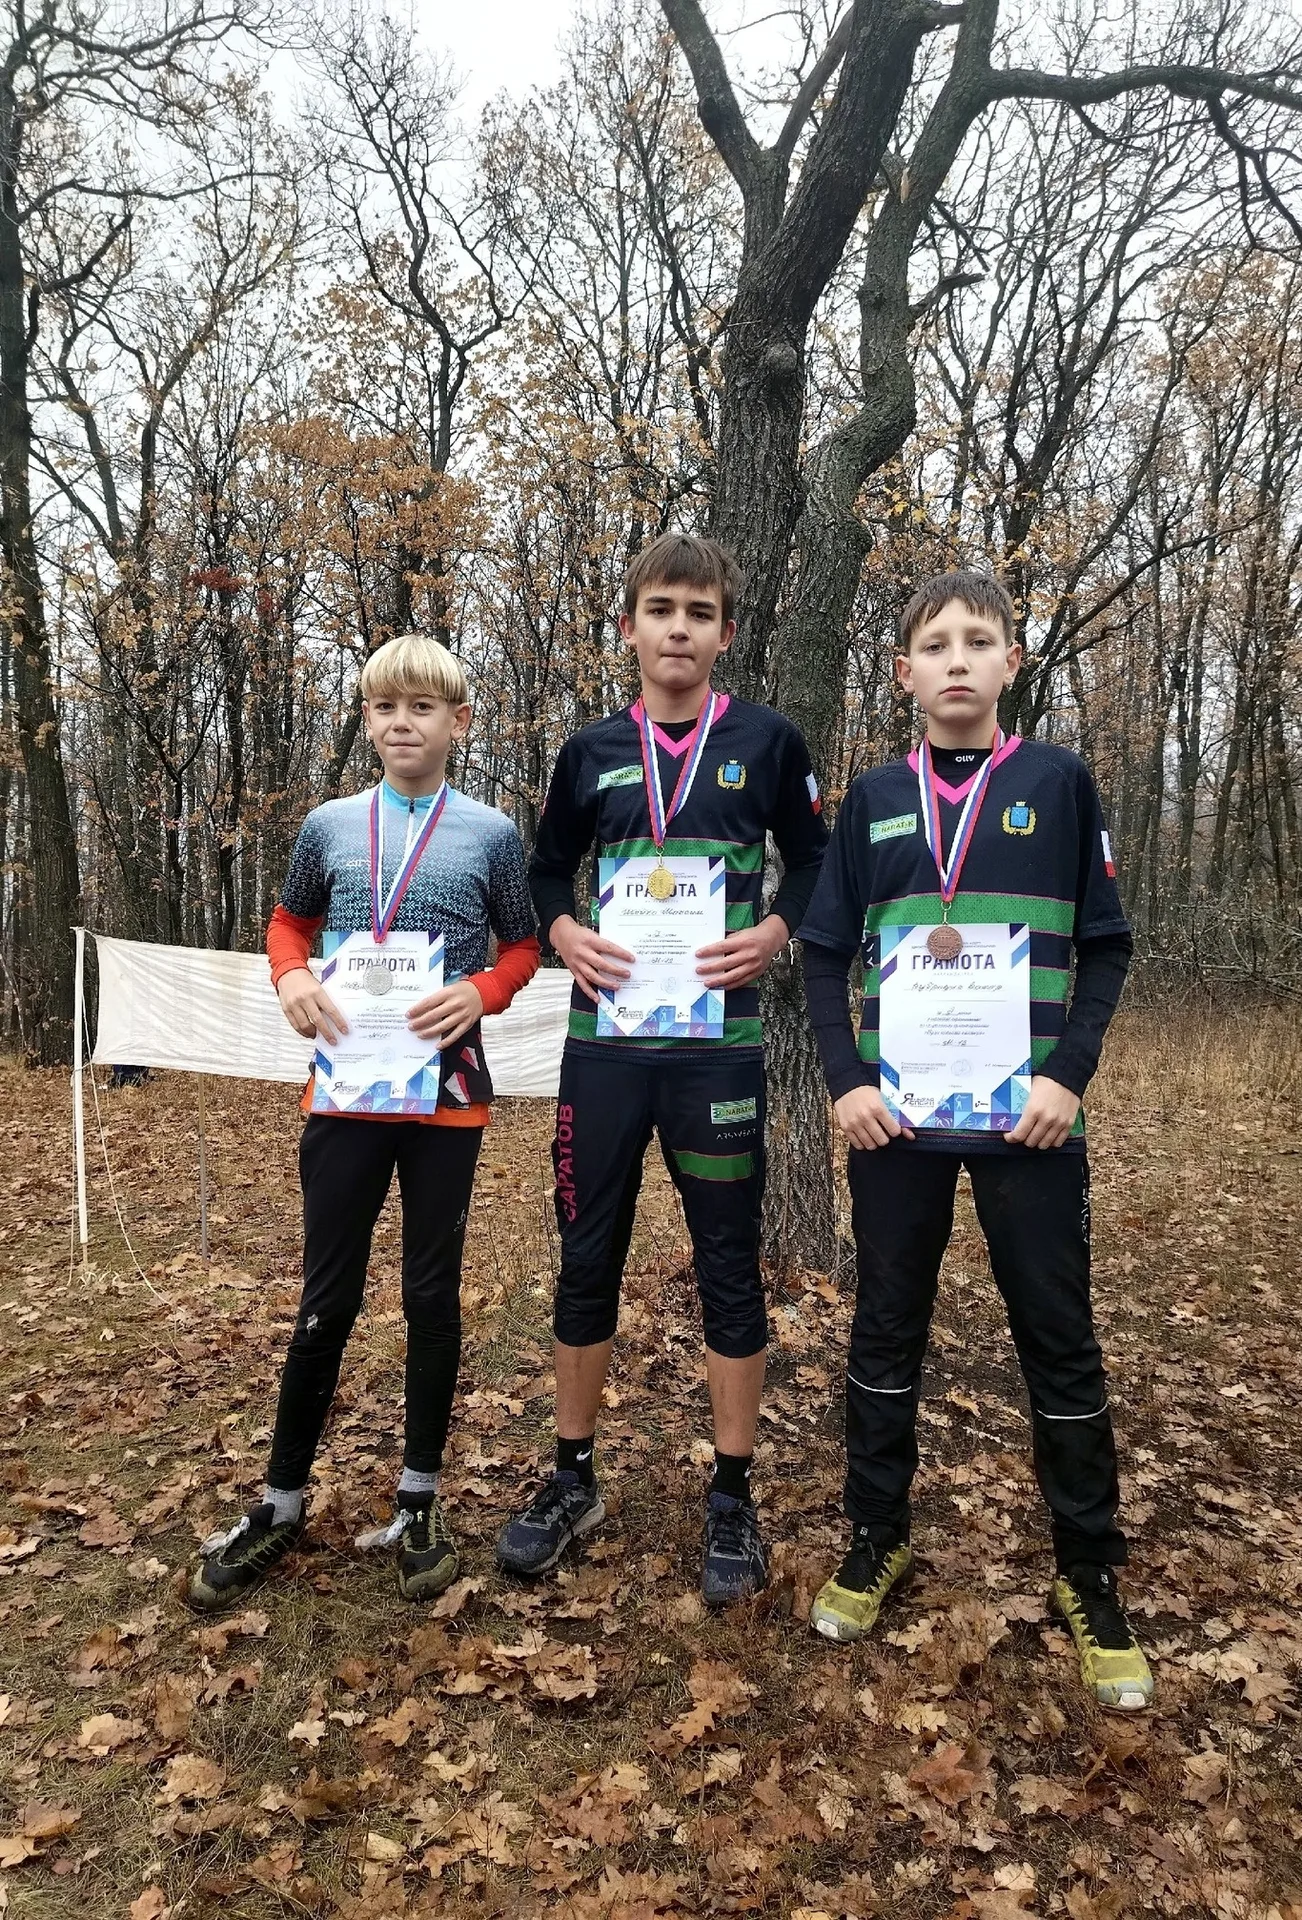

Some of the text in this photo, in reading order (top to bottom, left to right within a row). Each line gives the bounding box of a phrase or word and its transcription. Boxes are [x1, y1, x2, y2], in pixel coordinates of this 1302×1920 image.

[626, 883, 698, 898] ГРАТА
[911, 953, 996, 970] ГРАМОТА
[558, 1104, 577, 1222] САРАТОВ
